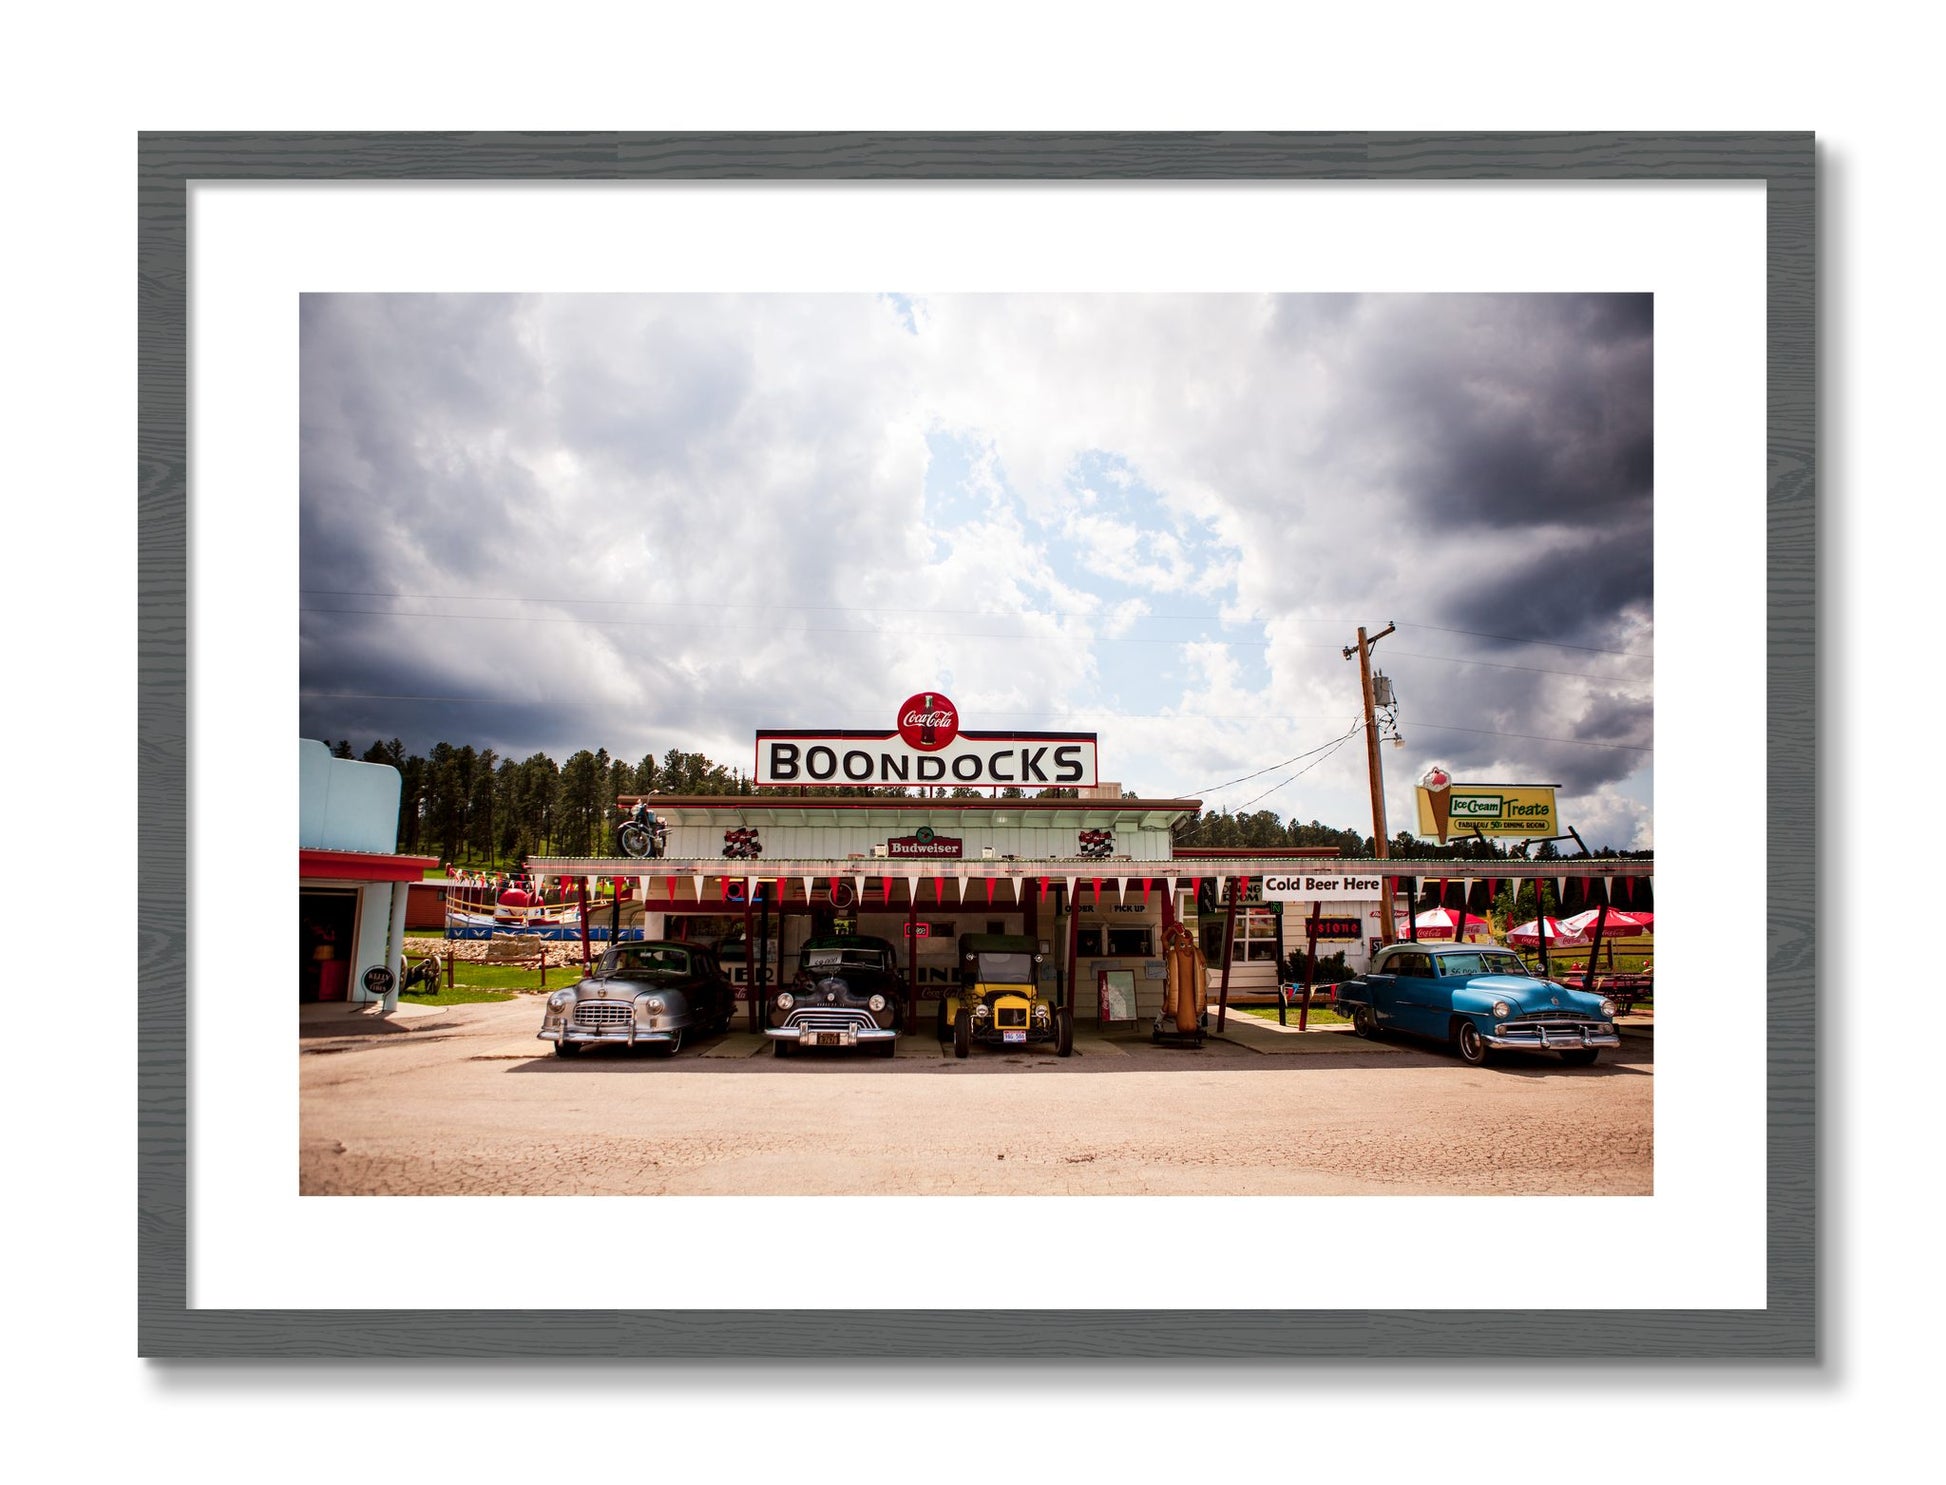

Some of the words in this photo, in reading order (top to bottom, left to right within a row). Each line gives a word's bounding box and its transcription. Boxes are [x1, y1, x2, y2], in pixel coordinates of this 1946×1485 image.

[903, 710, 954, 729] Coca-Cola
[769, 742, 1084, 783] BOONDOCKS
[1503, 799, 1549, 818] Treats
[1503, 821, 1525, 829] DINING
[1526, 821, 1546, 829] ROOM
[891, 842, 959, 853] Budweiser
[1265, 877, 1301, 891] Cold
[1305, 877, 1340, 891] Beer
[1343, 877, 1380, 891] Here
[1064, 904, 1094, 912] ODER
[1114, 904, 1132, 912] PICK
[1133, 904, 1146, 913] UP
